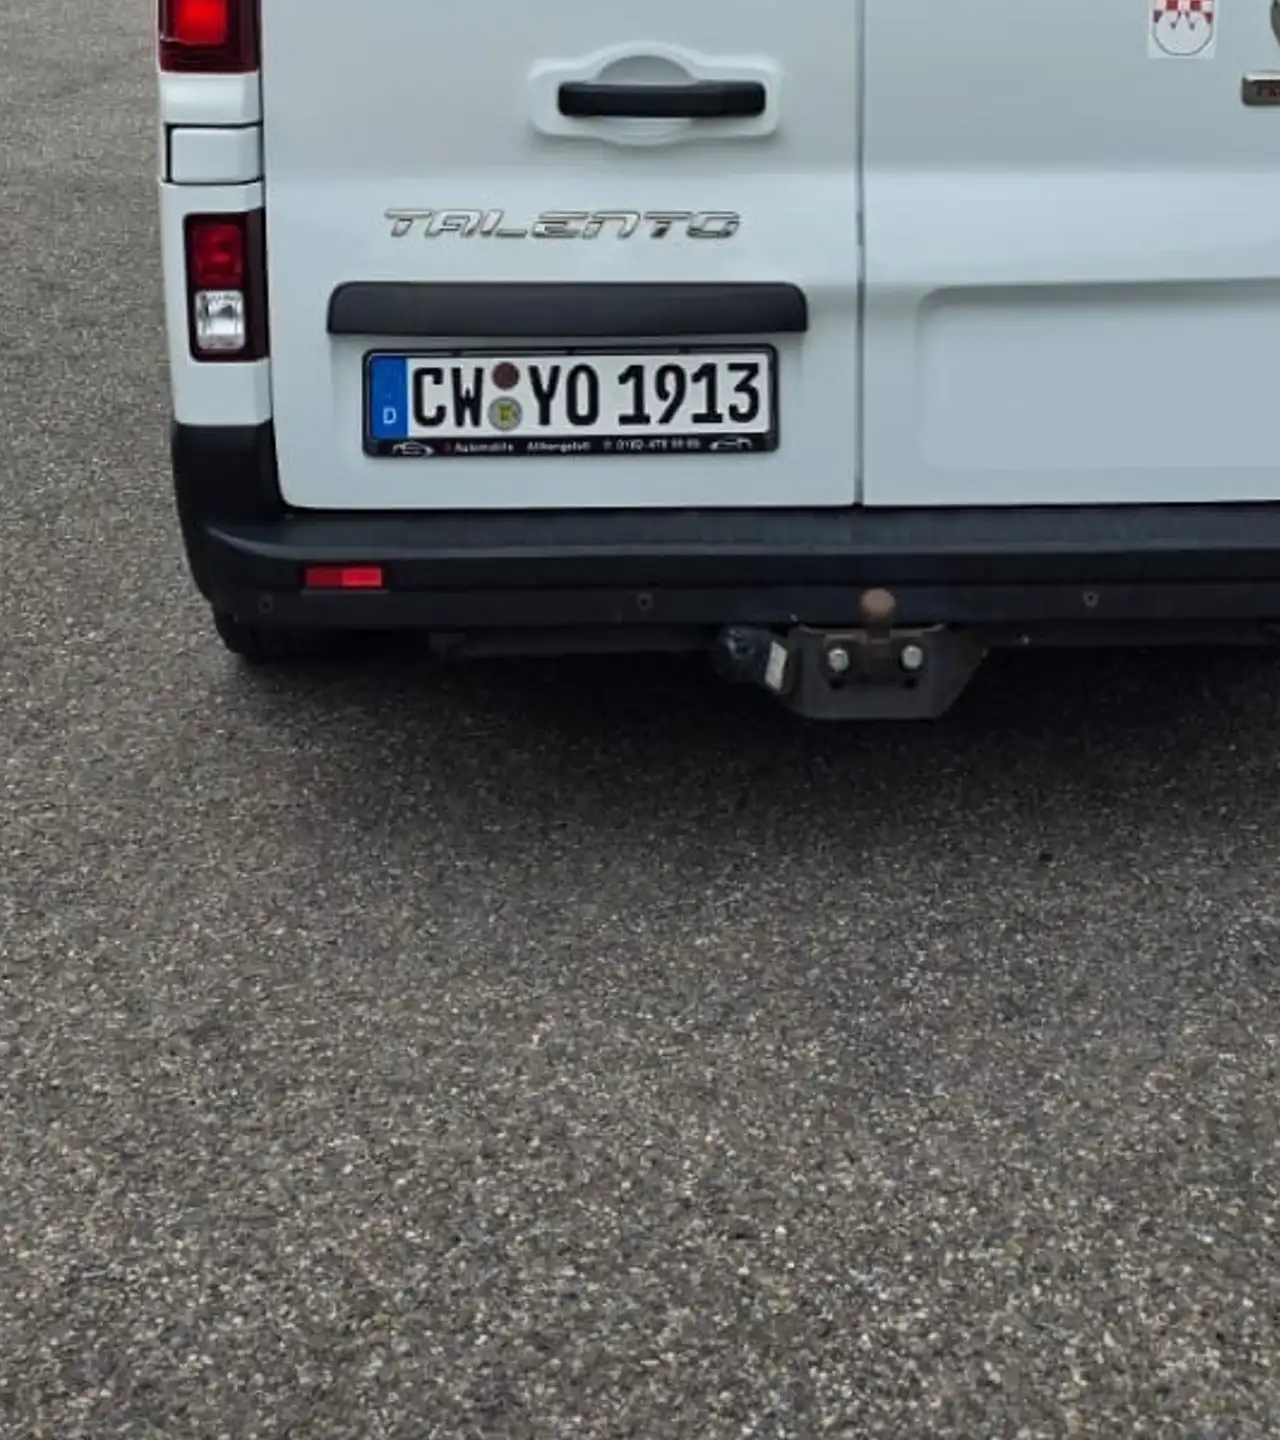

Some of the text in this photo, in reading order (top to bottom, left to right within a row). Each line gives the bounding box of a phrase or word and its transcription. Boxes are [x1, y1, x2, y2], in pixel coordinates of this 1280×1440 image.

[384, 209, 741, 239] TALENTO
[383, 362, 761, 428] D CW YO 1913
